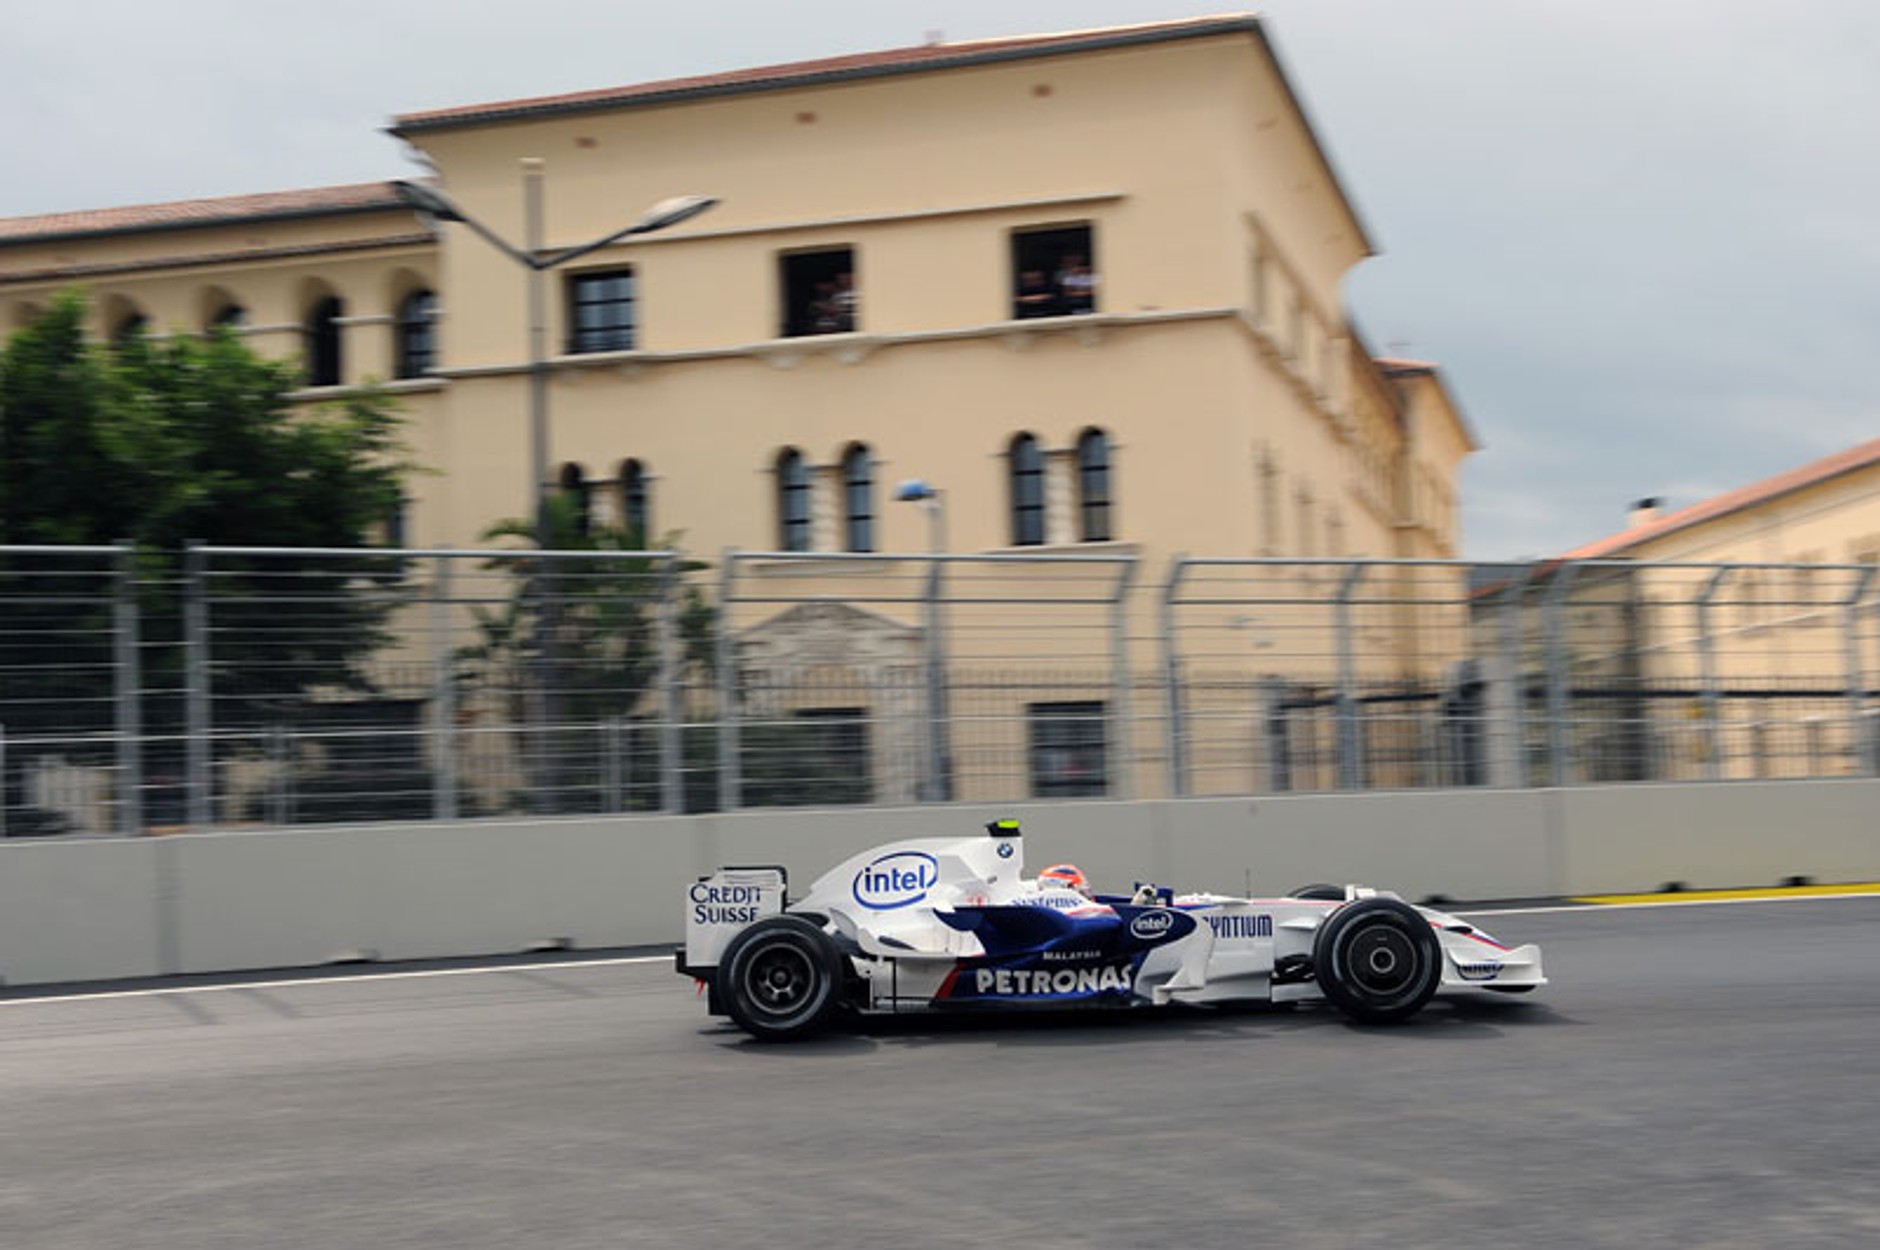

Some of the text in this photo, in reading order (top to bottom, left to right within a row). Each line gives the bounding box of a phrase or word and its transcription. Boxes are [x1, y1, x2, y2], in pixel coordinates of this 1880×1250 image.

[864, 864, 925, 893] intel
[690, 883, 761, 904] CREDIT
[695, 904, 759, 924] SUISSE
[1202, 914, 1273, 938] YNTIUM
[976, 963, 1134, 994] PETRONAS
